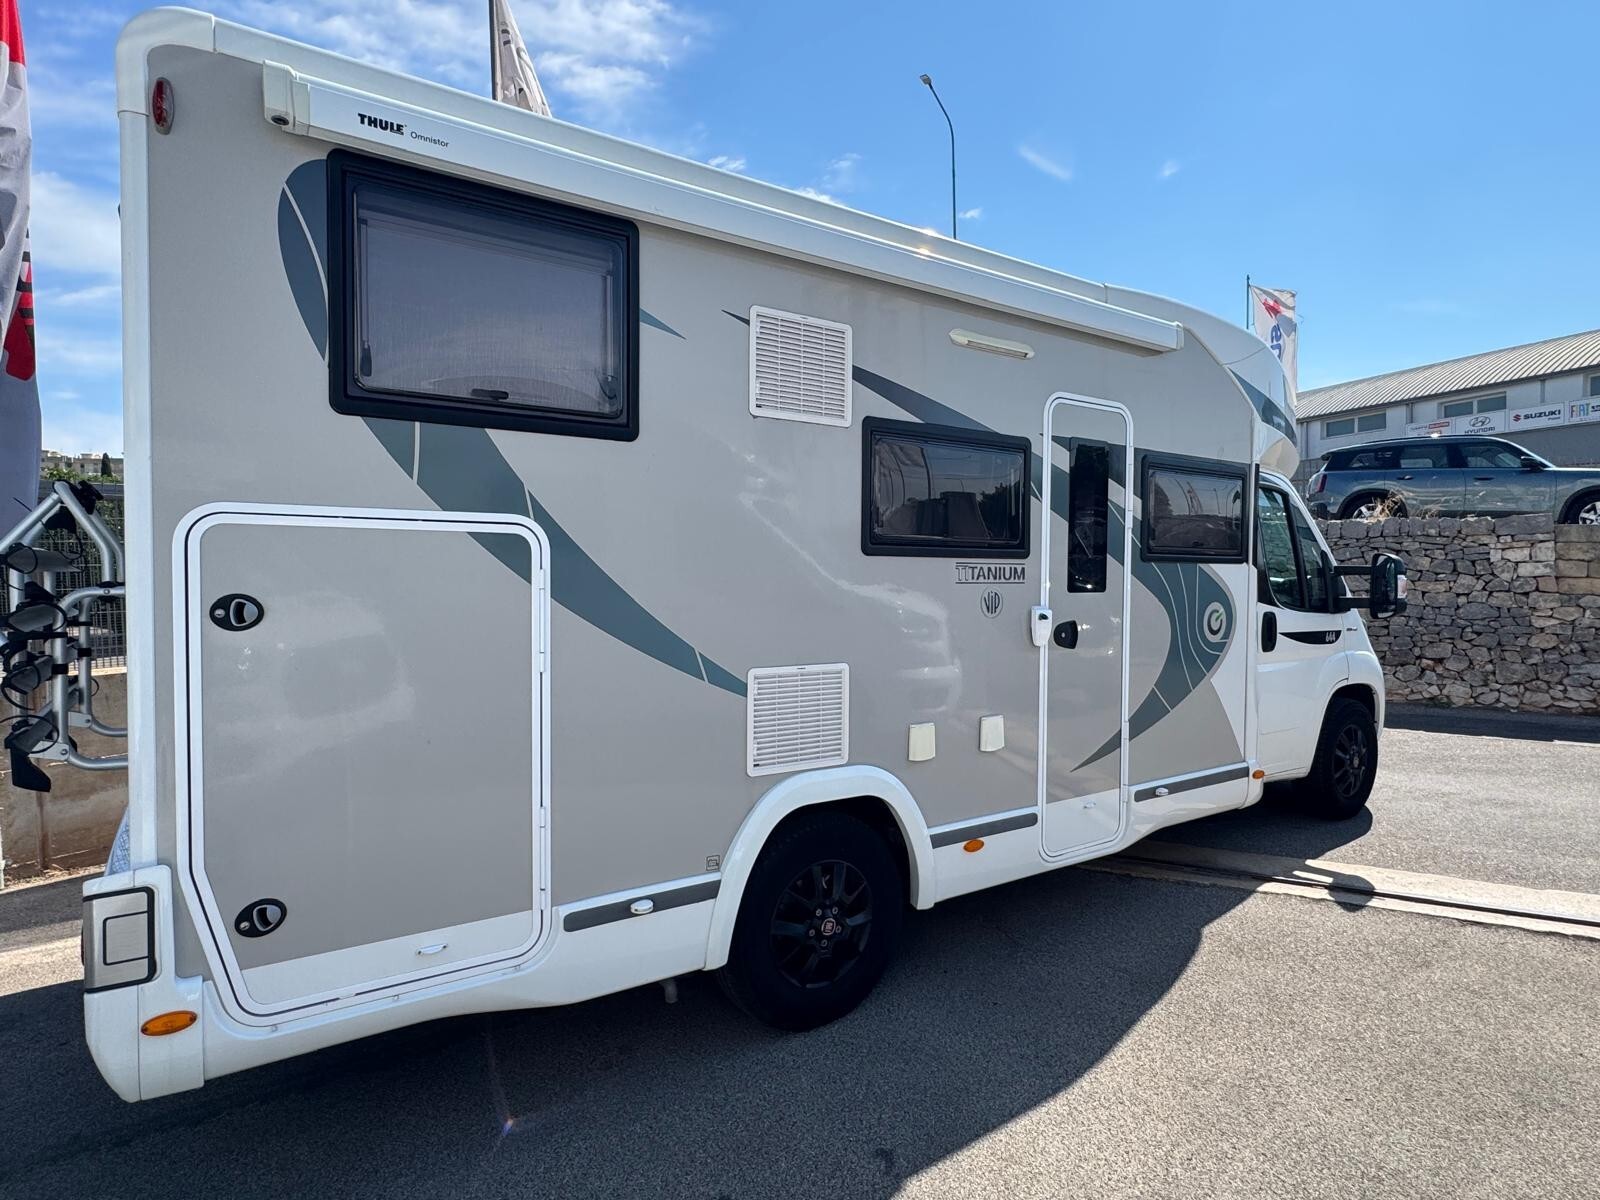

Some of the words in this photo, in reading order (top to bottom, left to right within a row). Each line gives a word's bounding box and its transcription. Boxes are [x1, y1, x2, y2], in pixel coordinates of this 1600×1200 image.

[357, 112, 404, 136] THULE
[410, 130, 449, 148] Omnistor
[1523, 409, 1561, 420] SUZUKI
[1570, 402, 1591, 418] FIAT
[1464, 426, 1496, 435] HYUNDAI
[955, 564, 1026, 581] TITANIUM
